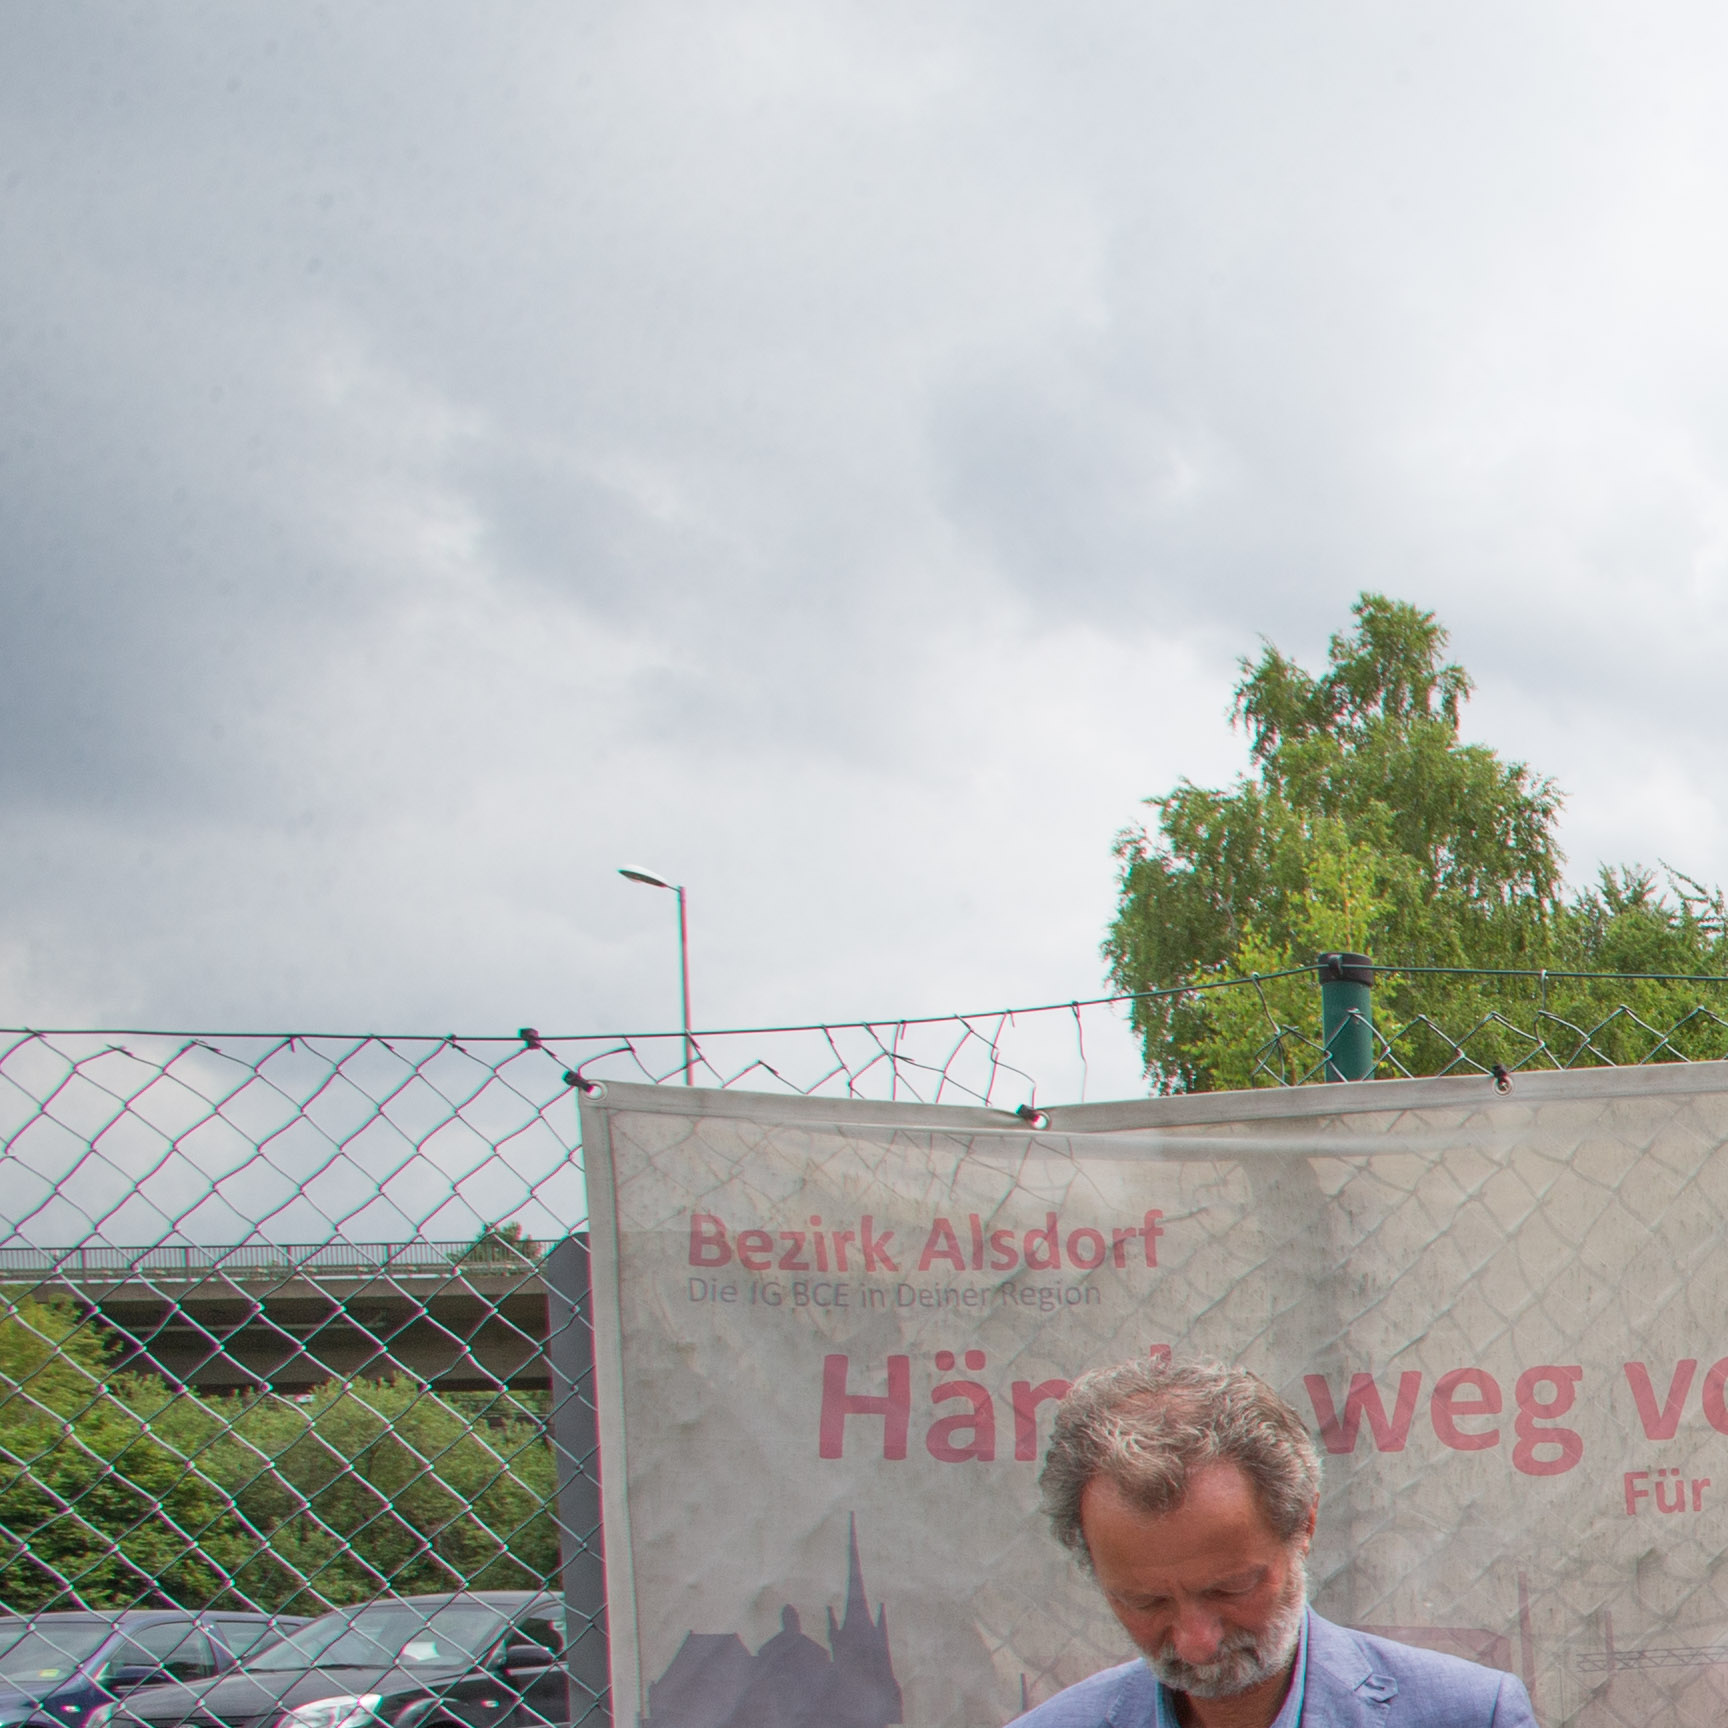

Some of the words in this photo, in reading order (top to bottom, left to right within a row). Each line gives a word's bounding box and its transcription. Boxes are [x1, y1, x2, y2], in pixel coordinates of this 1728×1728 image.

[688, 1213, 898, 1272] Bezirk
[918, 1209, 1165, 1272] Alsdorf
[688, 1277, 738, 1303] Die
[751, 1279, 781, 1305] IG
[794, 1281, 849, 1307] BCE
[862, 1281, 886, 1308] in
[896, 1281, 992, 1308] Deiner
[1001, 1282, 1101, 1313] Region
[1303, 1364, 1584, 1477] weg
[1623, 1466, 1711, 1516] Für
